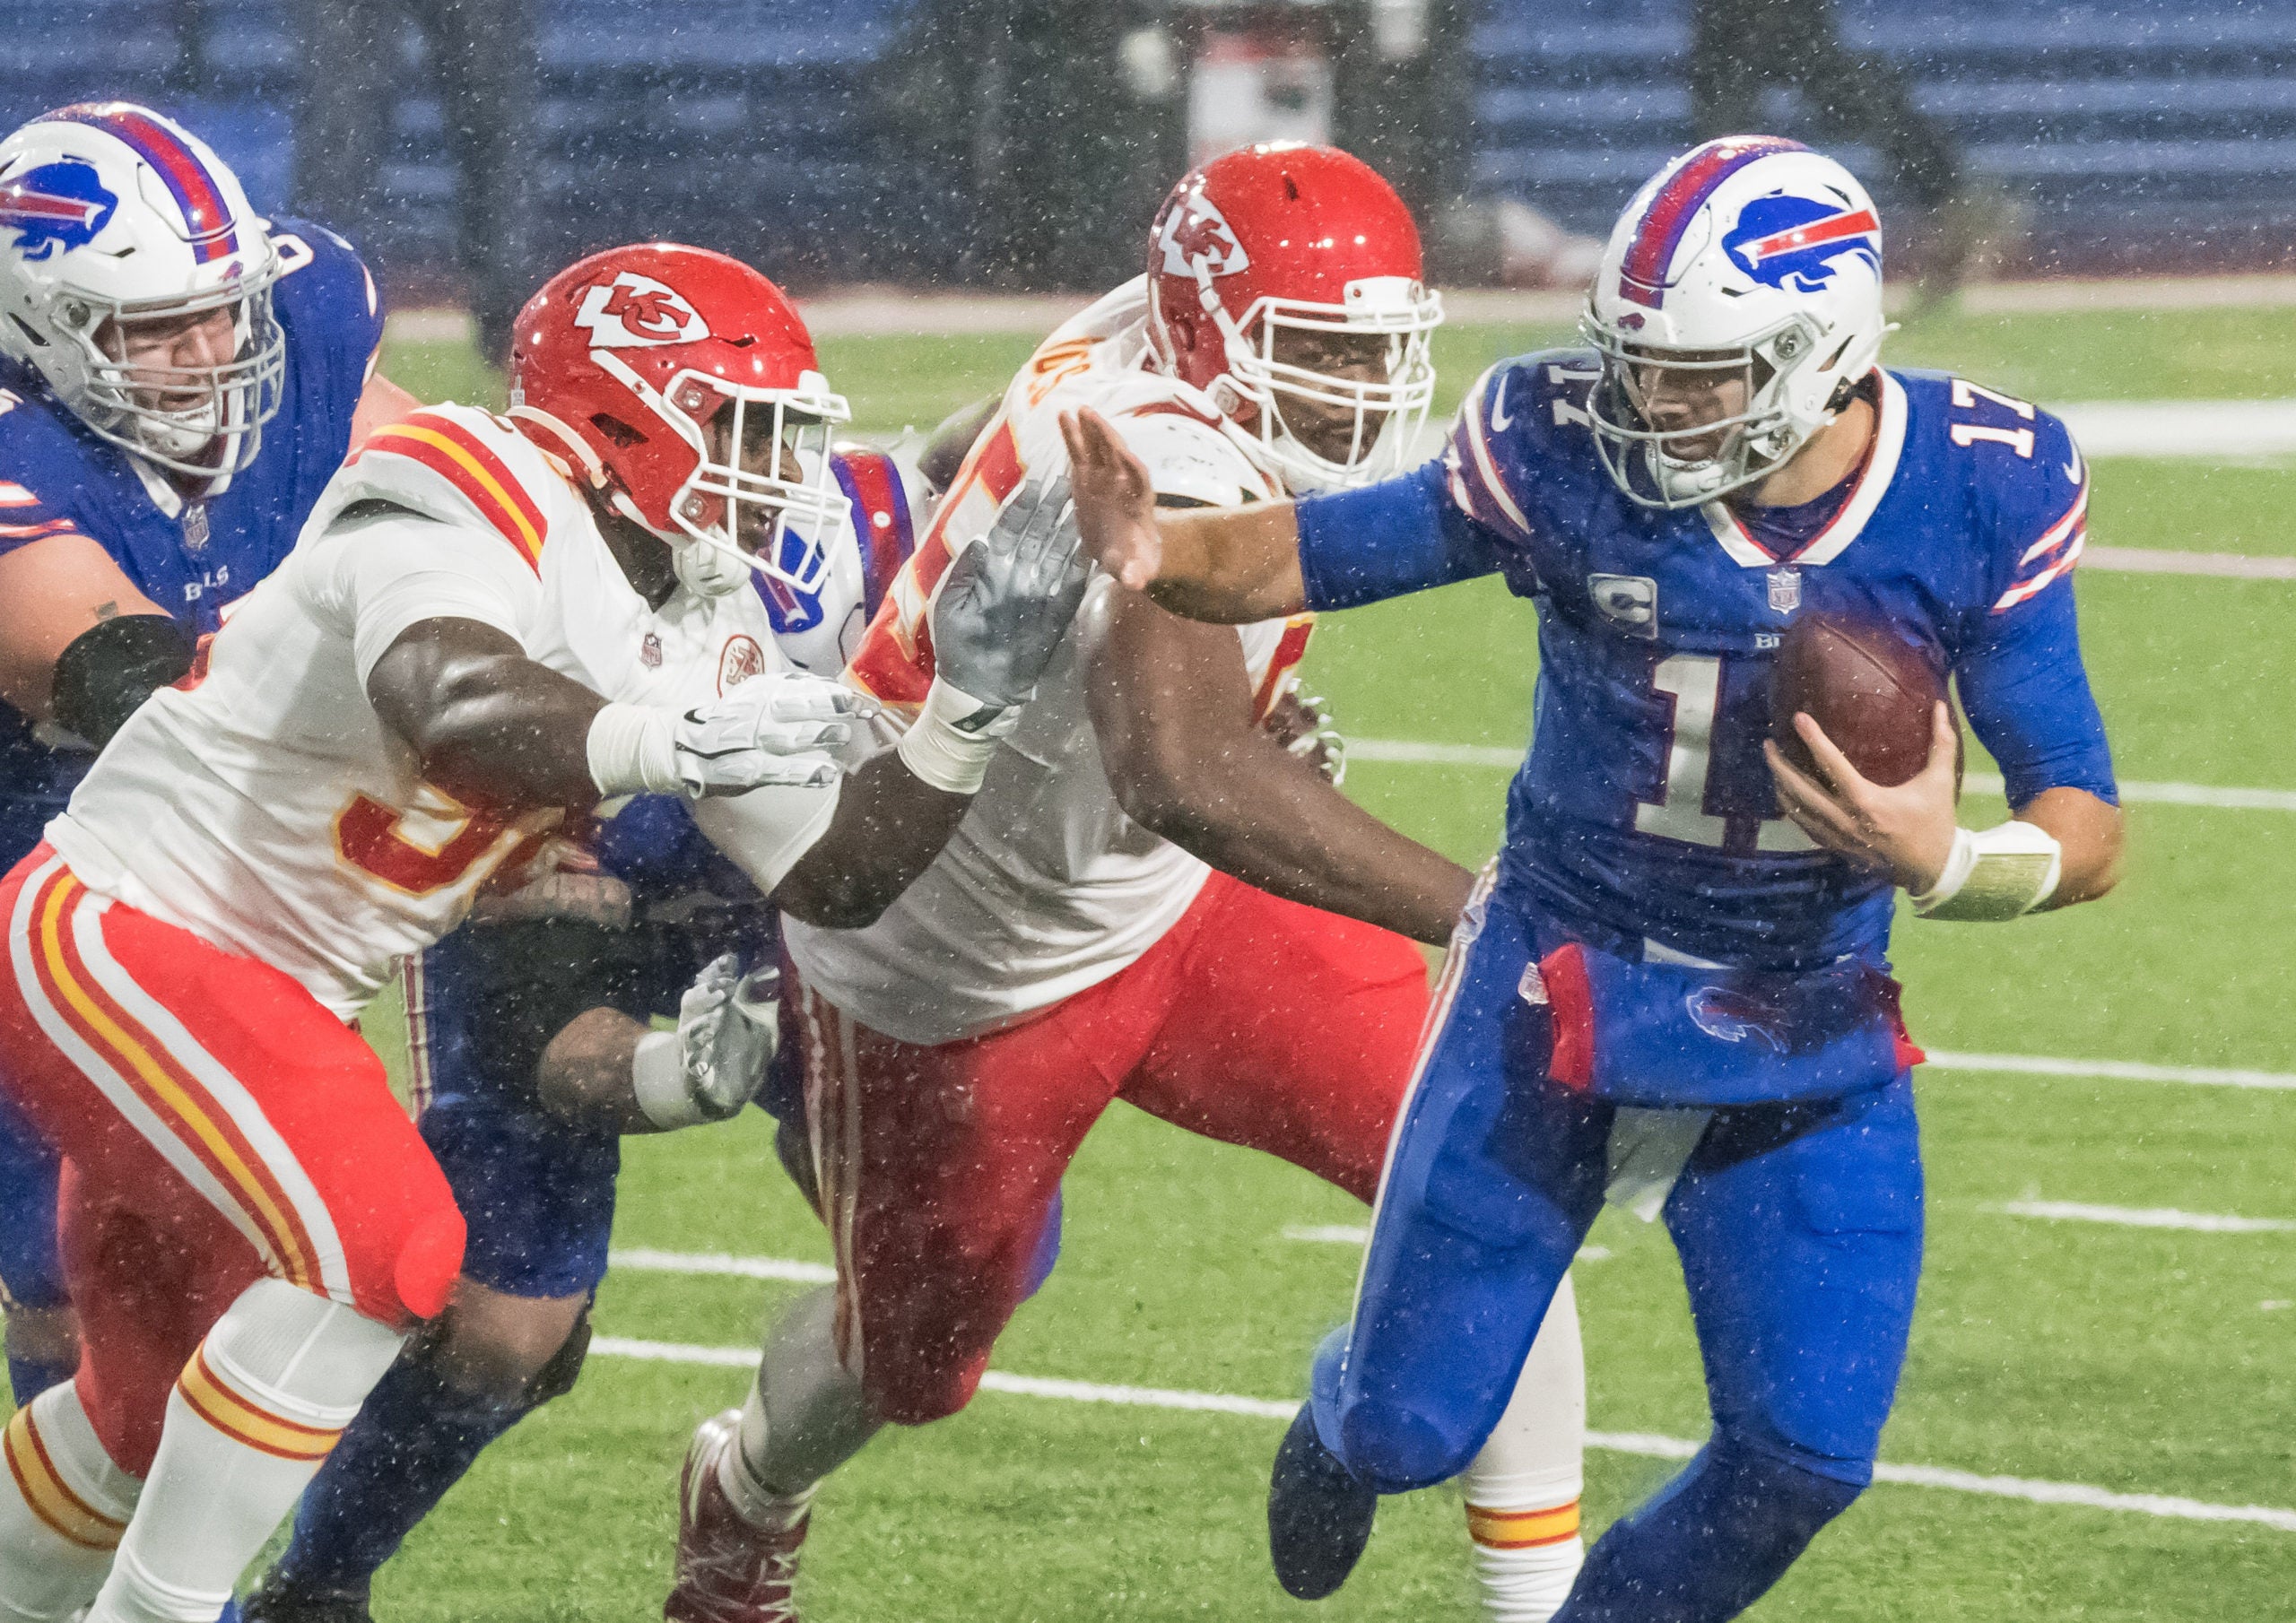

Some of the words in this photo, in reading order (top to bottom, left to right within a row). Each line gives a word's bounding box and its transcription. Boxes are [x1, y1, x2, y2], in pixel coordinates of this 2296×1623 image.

[1171, 207, 1234, 273] KC
[601, 285, 691, 341] KC
[1951, 378, 2035, 458] 17
[1634, 653, 1824, 852] 1
